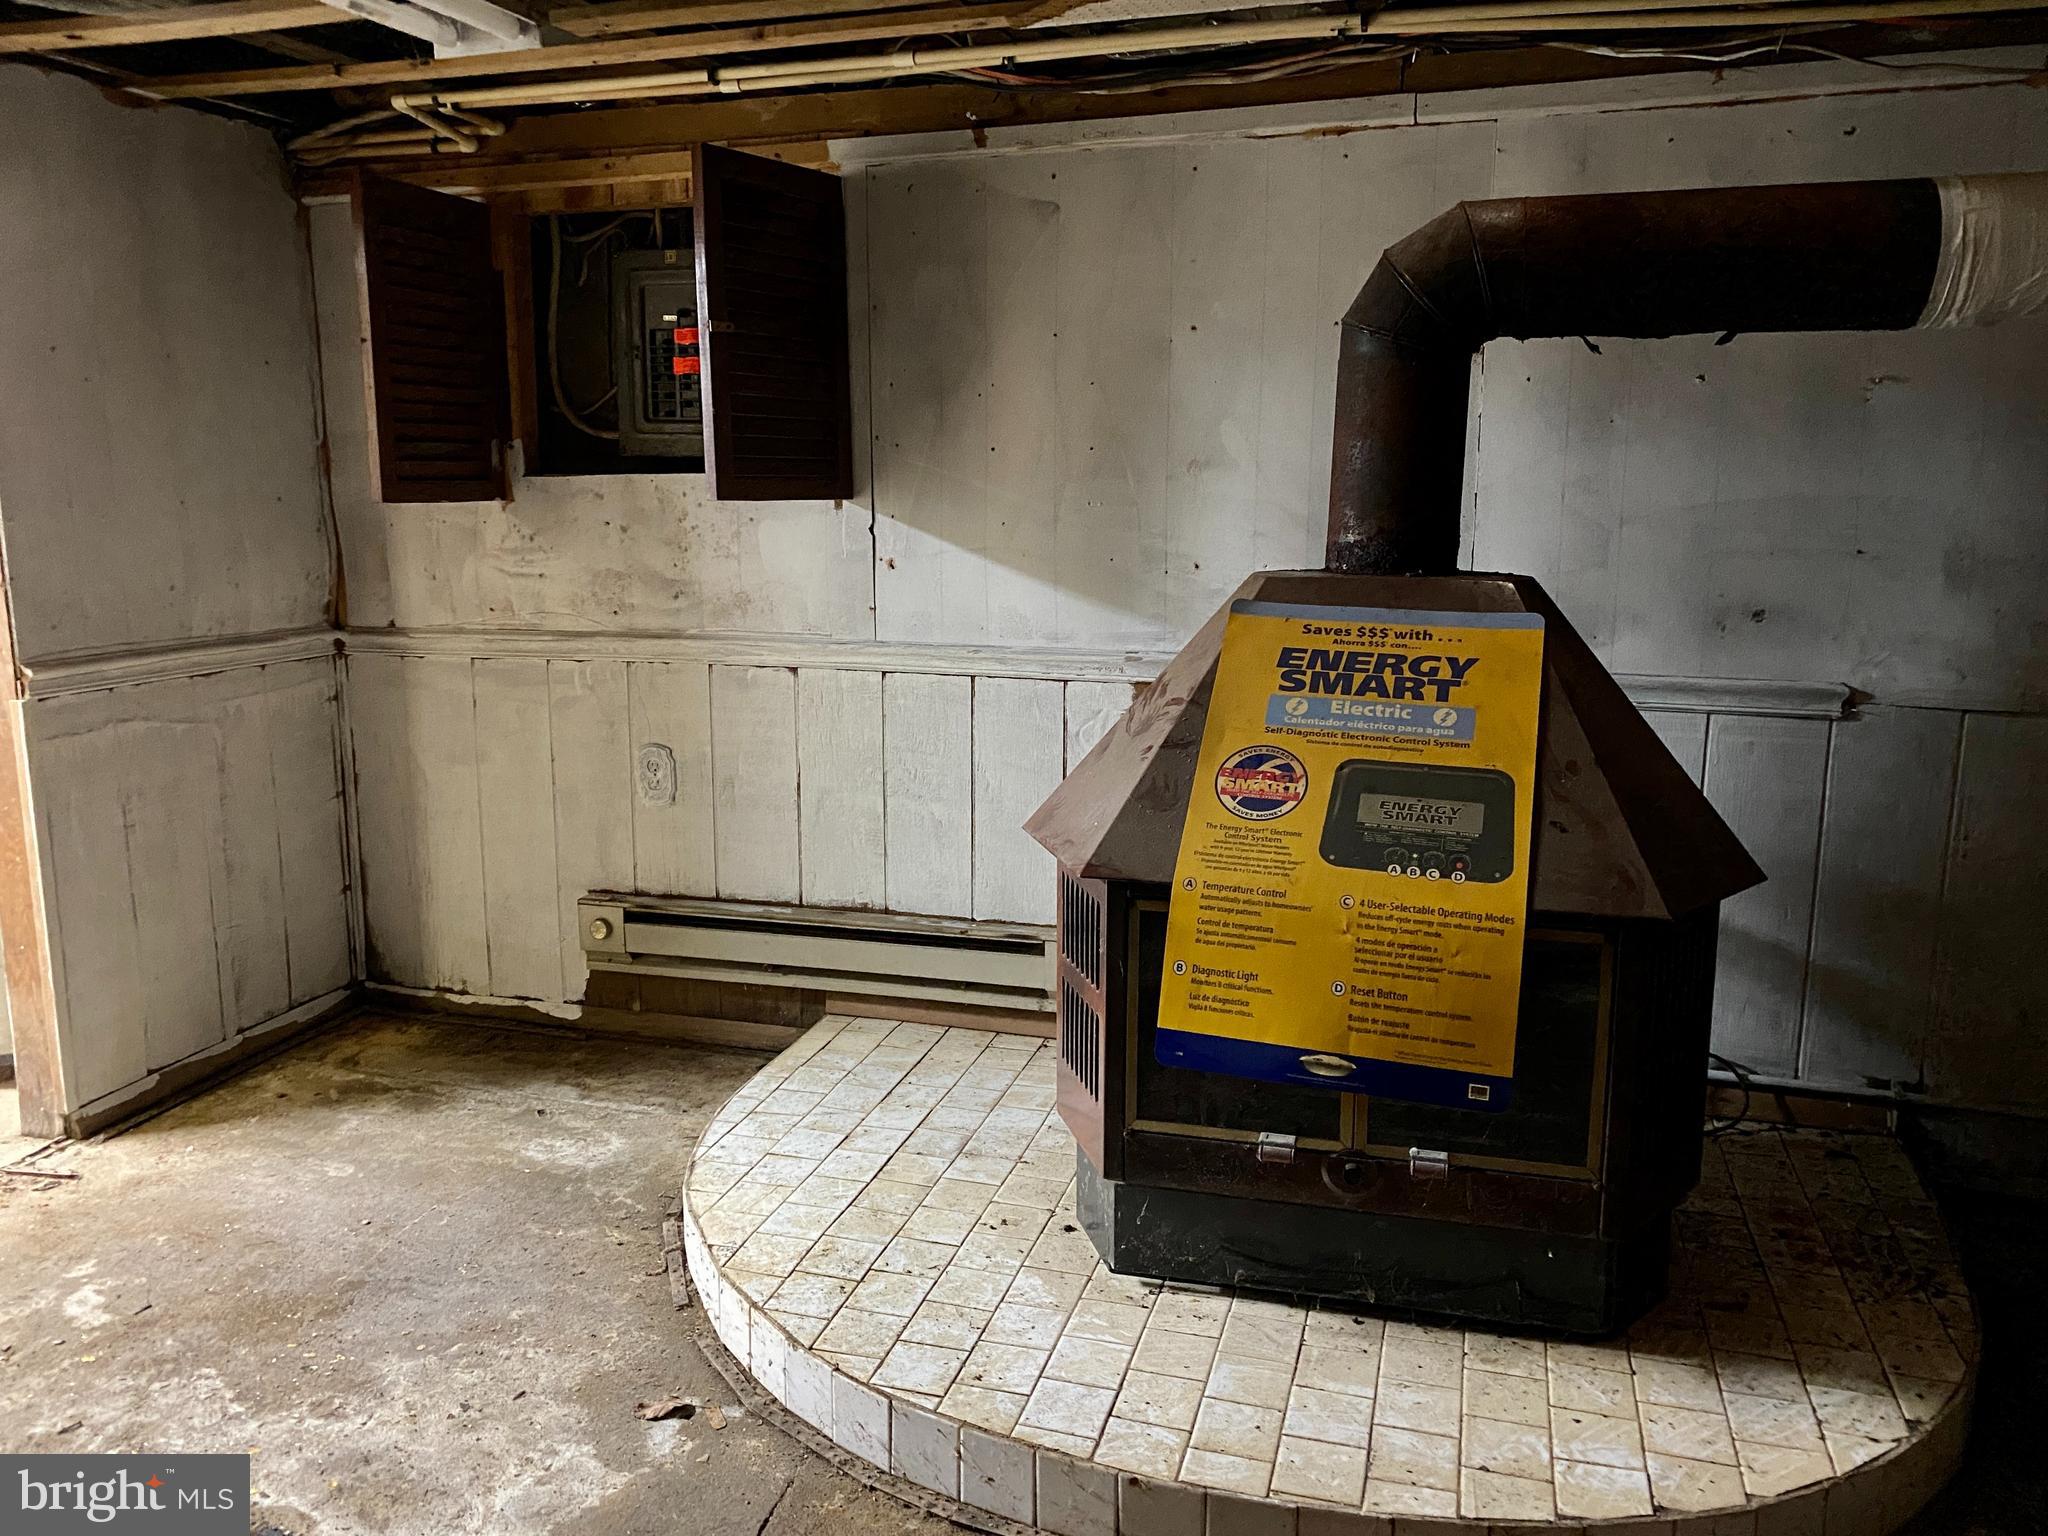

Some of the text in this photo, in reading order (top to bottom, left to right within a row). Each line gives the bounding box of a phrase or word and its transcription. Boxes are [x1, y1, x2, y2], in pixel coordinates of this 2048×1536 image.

[1302, 624, 1351, 636] Saves
[1394, 630, 1433, 641] with
[1276, 647, 1480, 679] ENERGY
[1330, 700, 1412, 719] Electric
[1284, 716, 1454, 736] Calentador eléctrico para agua
[1265, 726, 1470, 748] Self-Diagnostic Electronic Control System
[1239, 748, 1295, 761] SAVES ENERGY
[1220, 767, 1304, 783] ENERGY
[1221, 777, 1298, 793] SMART
[1232, 805, 1283, 818] SAVES MONEY
[1380, 801, 1462, 816] ENERGY
[1383, 810, 1458, 825] SMART
[1220, 823, 1242, 833] Energy
[1270, 828, 1303, 837] Electronic
[1225, 832, 1282, 843] Control System
[1186, 879, 1286, 898] A Temperature Control
[1200, 893, 1240, 904] Automatically
[1343, 897, 1515, 925] C 4 User-Selectable Operating Modes
[1197, 917, 1220, 926] Control
[1232, 923, 1273, 933] temperatura
[1473, 926, 1505, 937] operating
[1176, 963, 1258, 982] B Diagnostic Light
[1189, 992, 1201, 1000] Luz
[1202, 994, 1210, 1002] de
[1335, 984, 1408, 1002] D Reset Button
